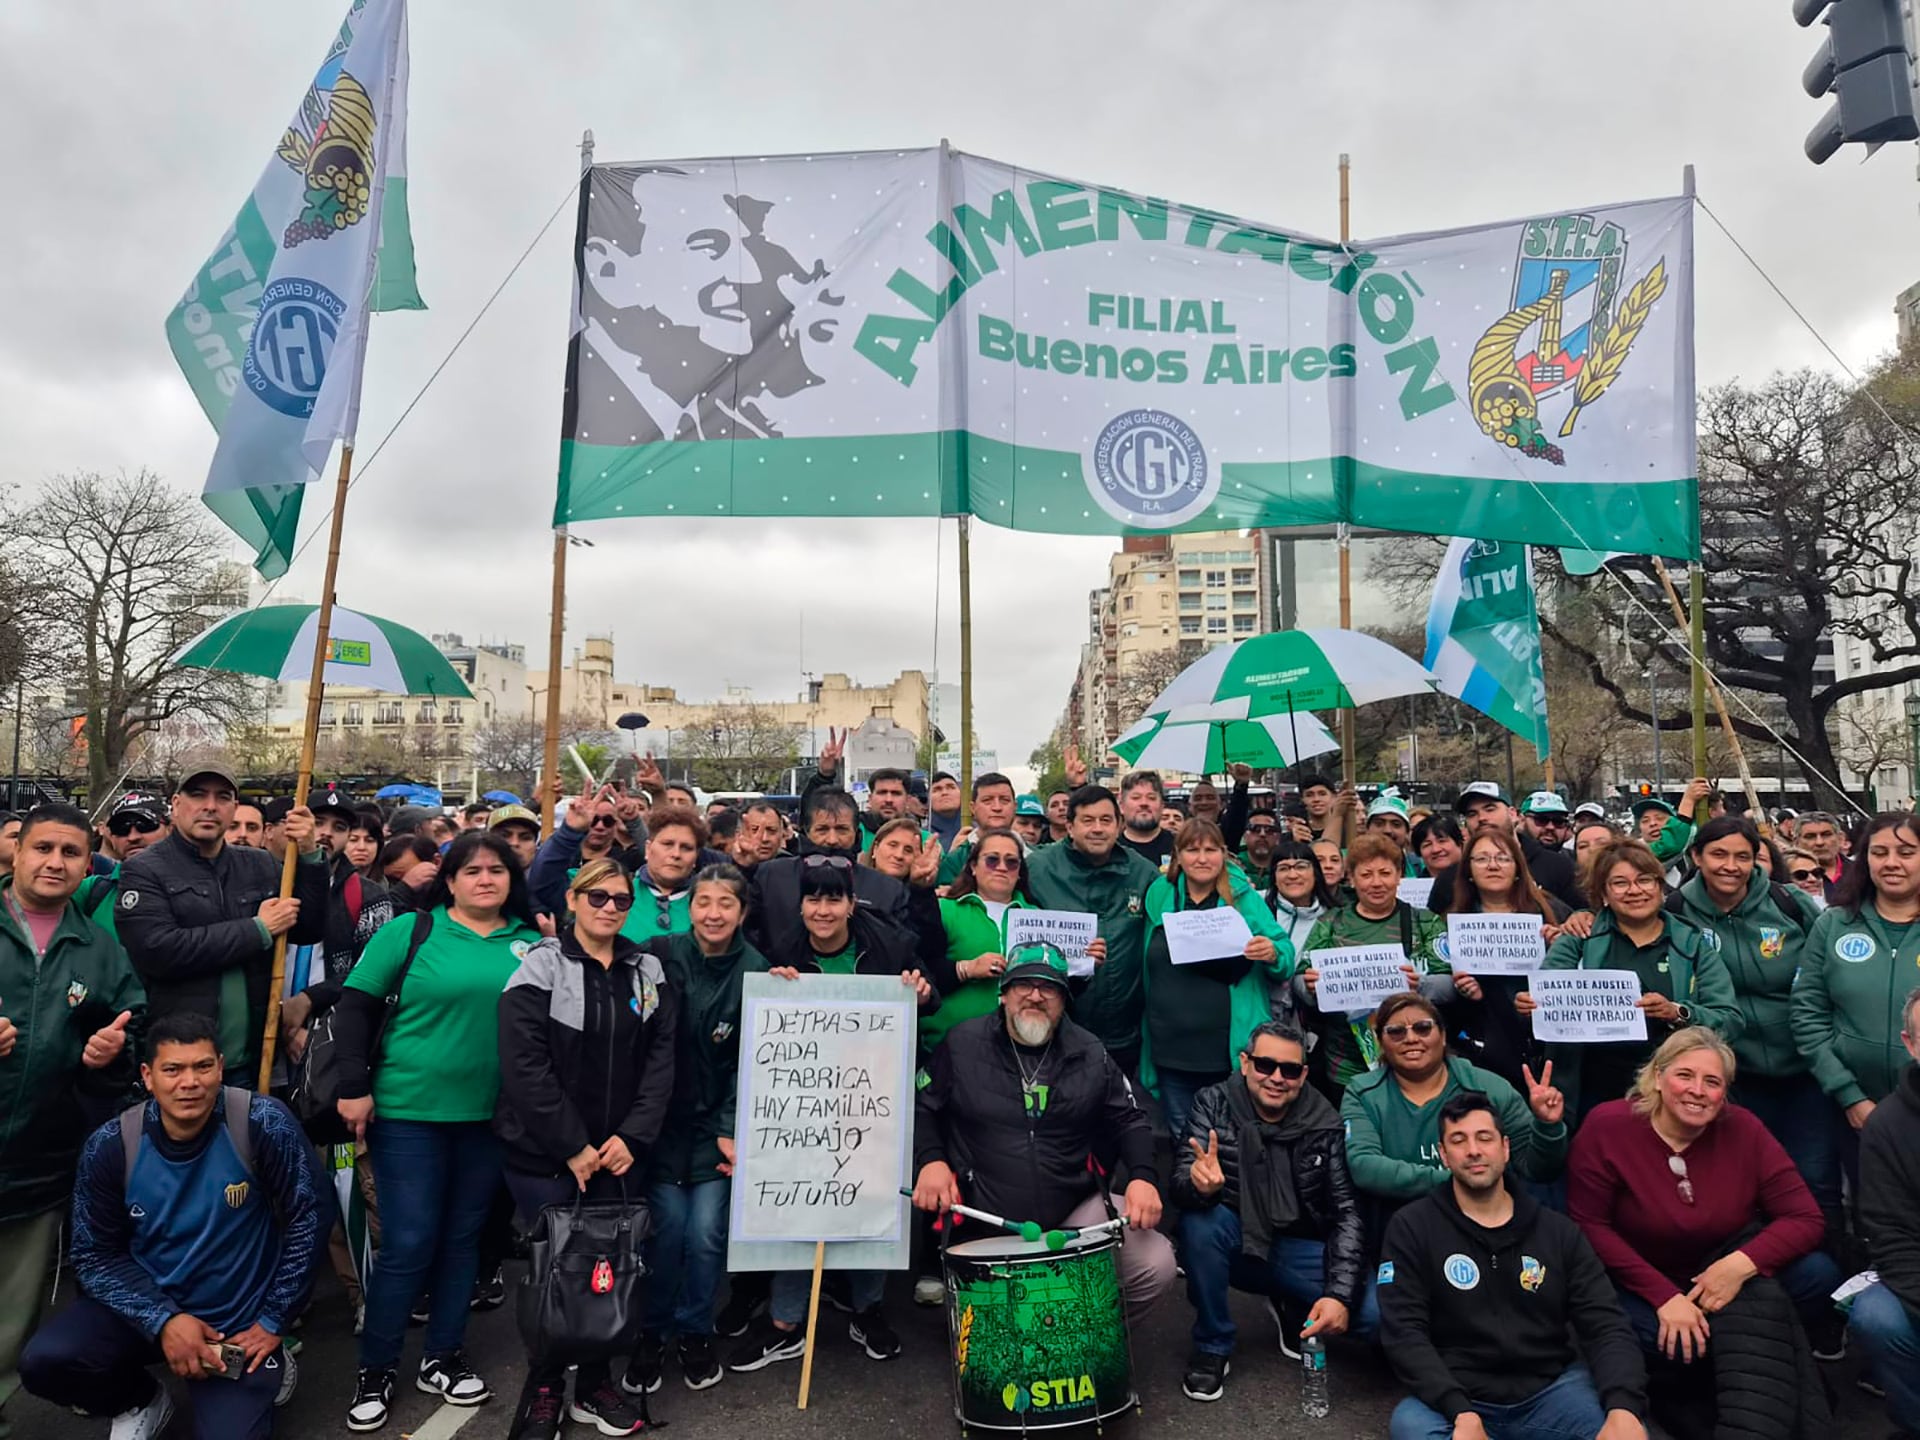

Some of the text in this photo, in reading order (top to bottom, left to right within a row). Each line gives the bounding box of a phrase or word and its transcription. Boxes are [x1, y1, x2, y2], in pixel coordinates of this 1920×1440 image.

[1089, 291, 1236, 334] FILIAL
[978, 313, 1357, 386] Buenos Aires
[1133, 412, 1181, 434] GENERAL
[1179, 430, 1197, 452] DEL
[1046, 920, 1056, 928] DE
[1489, 922, 1499, 930] DE
[1480, 934, 1537, 945] INDUSTRIAS
[1460, 946, 1473, 957] NO
[1476, 947, 1494, 958] HAY
[1352, 955, 1361, 963] DE
[1344, 965, 1399, 978] INDUSTRIAS
[1326, 983, 1339, 994] NO
[1341, 982, 1359, 993] HAY
[1576, 980, 1589, 989] DE
[1542, 995, 1633, 1008] ¡SIN INDUSTRIAS
[760, 1007, 895, 1037] DETRAS DE
[1544, 1010, 1637, 1022] NO HAY TRABAJO!
[756, 1041, 819, 1065] CADA
[754, 1096, 791, 1123] HAY
[833, 1155, 851, 1178] Y
[1030, 1374, 1096, 1408] STIA
